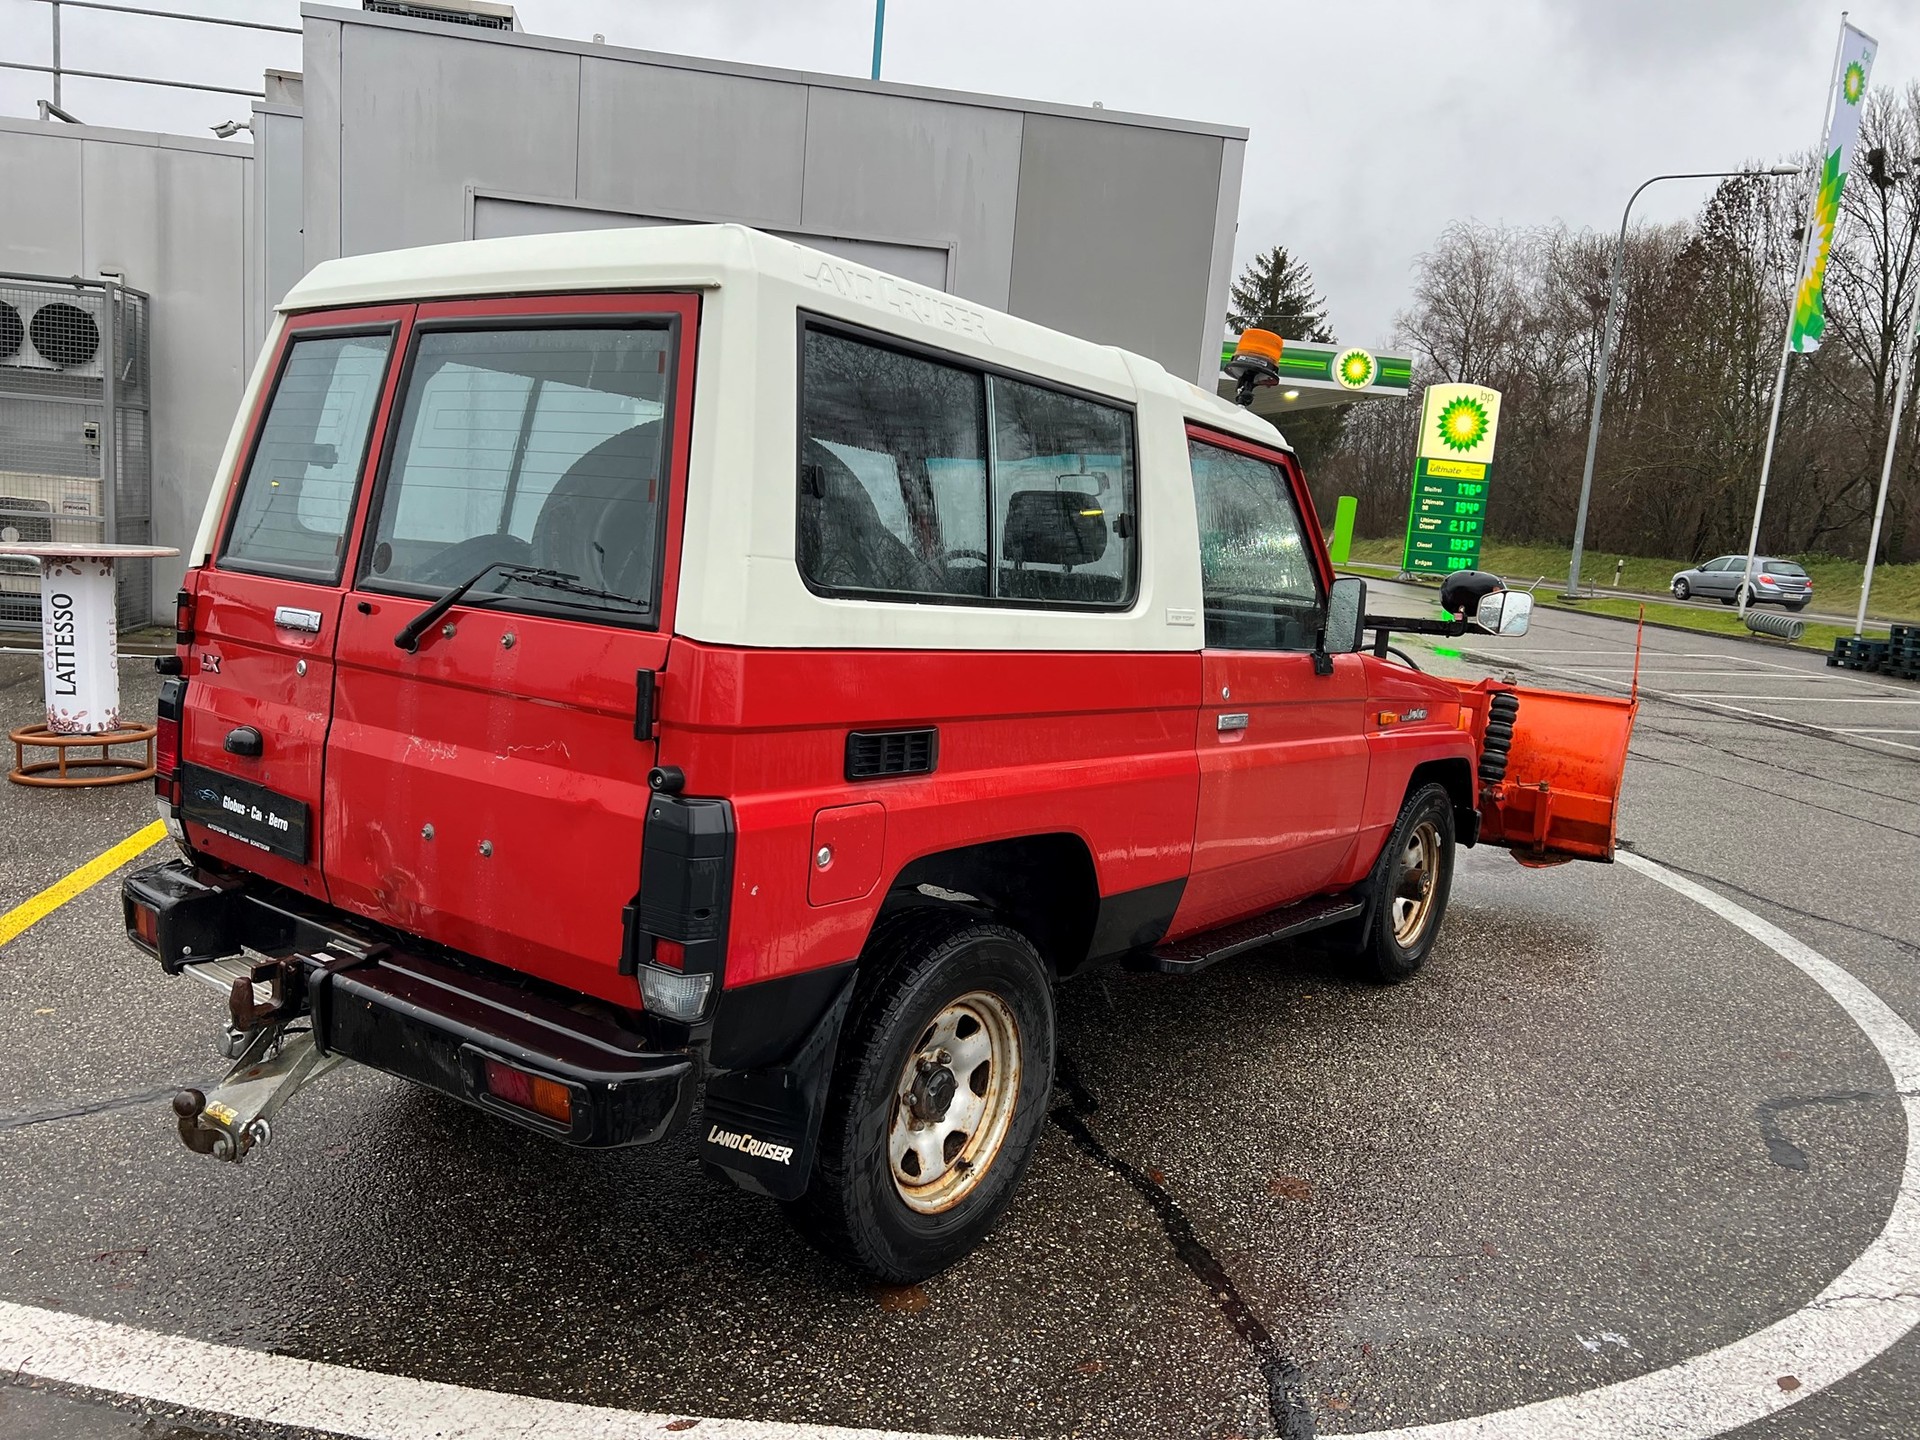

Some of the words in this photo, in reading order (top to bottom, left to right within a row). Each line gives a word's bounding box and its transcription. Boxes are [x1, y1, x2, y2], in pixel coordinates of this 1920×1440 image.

[1480, 390, 1495, 404] bp
[1420, 517, 1442, 525] Ultimate
[1414, 559, 1433, 567] Erdgas
[51, 593, 77, 696] LATTESSO
[222, 795, 246, 815] Globus
[268, 812, 289, 832] Berro
